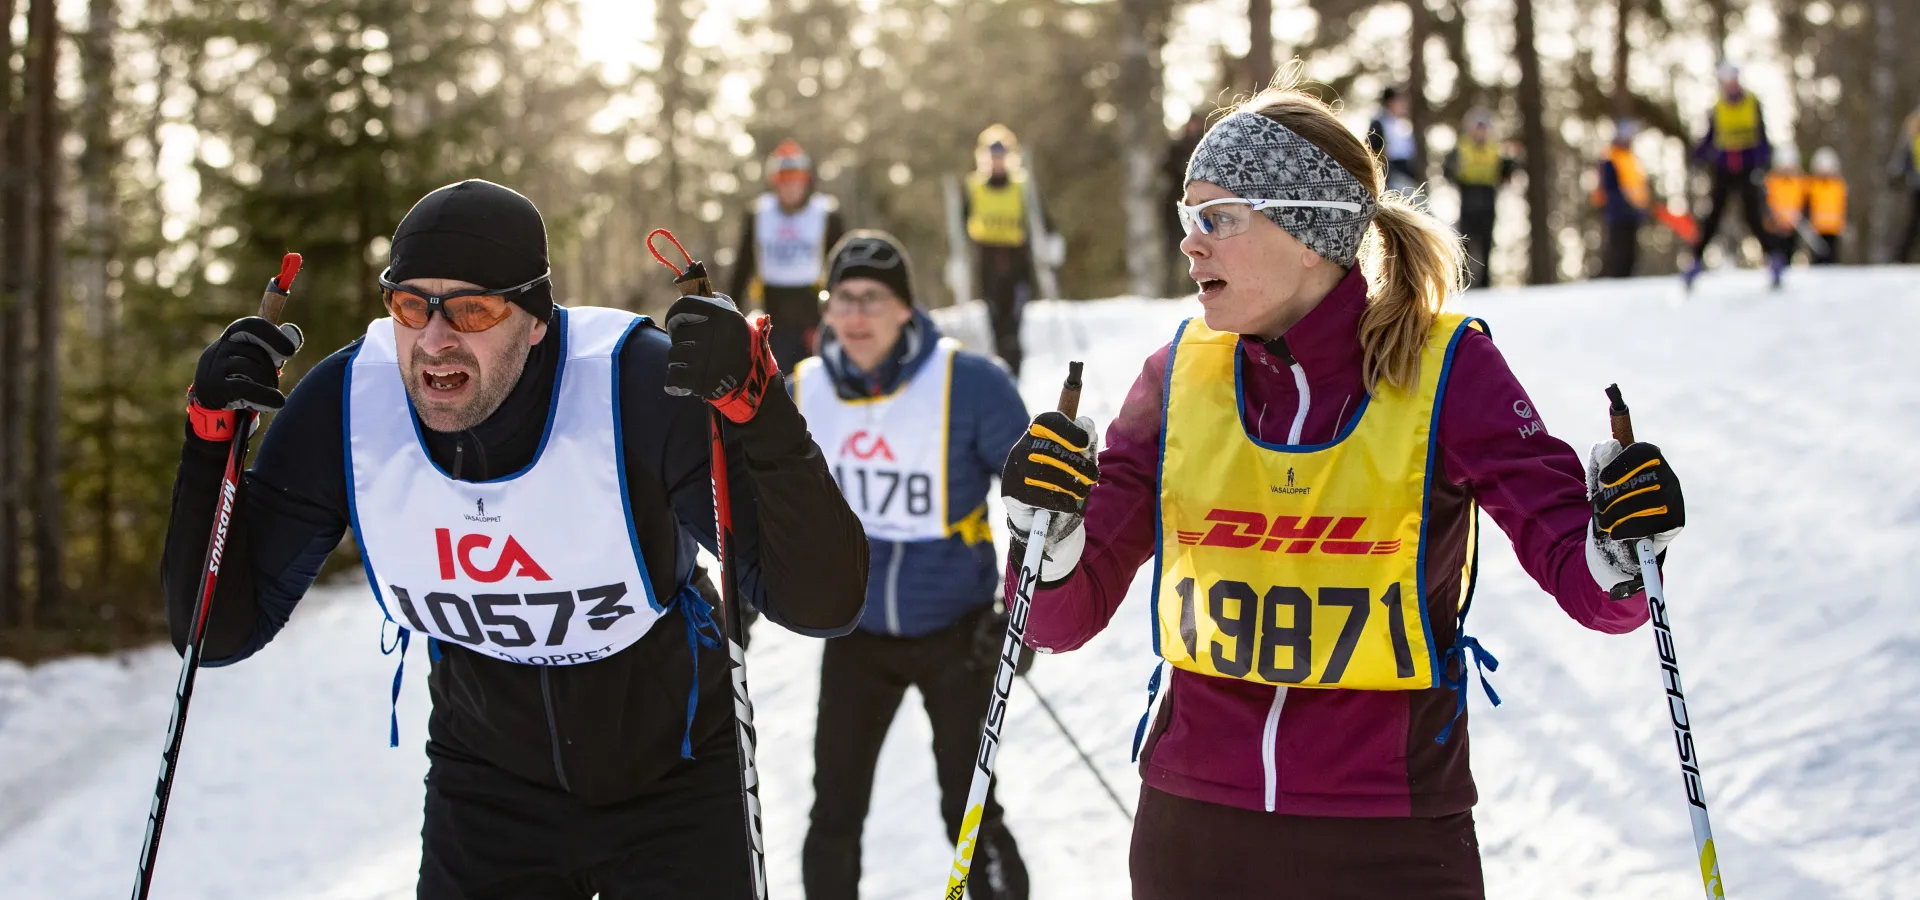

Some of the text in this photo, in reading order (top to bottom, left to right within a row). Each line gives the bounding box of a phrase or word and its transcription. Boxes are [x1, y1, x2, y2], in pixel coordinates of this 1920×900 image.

[463, 513, 502, 523] VASALOPPET
[1270, 484, 1311, 495] VASALOPPET
[209, 478, 237, 577] MADSHUS
[435, 528, 553, 583] ICA
[1200, 508, 1375, 555] DHL
[390, 582, 636, 648] 10573
[1175, 577, 1415, 684] 19871
[977, 565, 1037, 778] FISCHER
[1649, 596, 1706, 811] FISCHER
